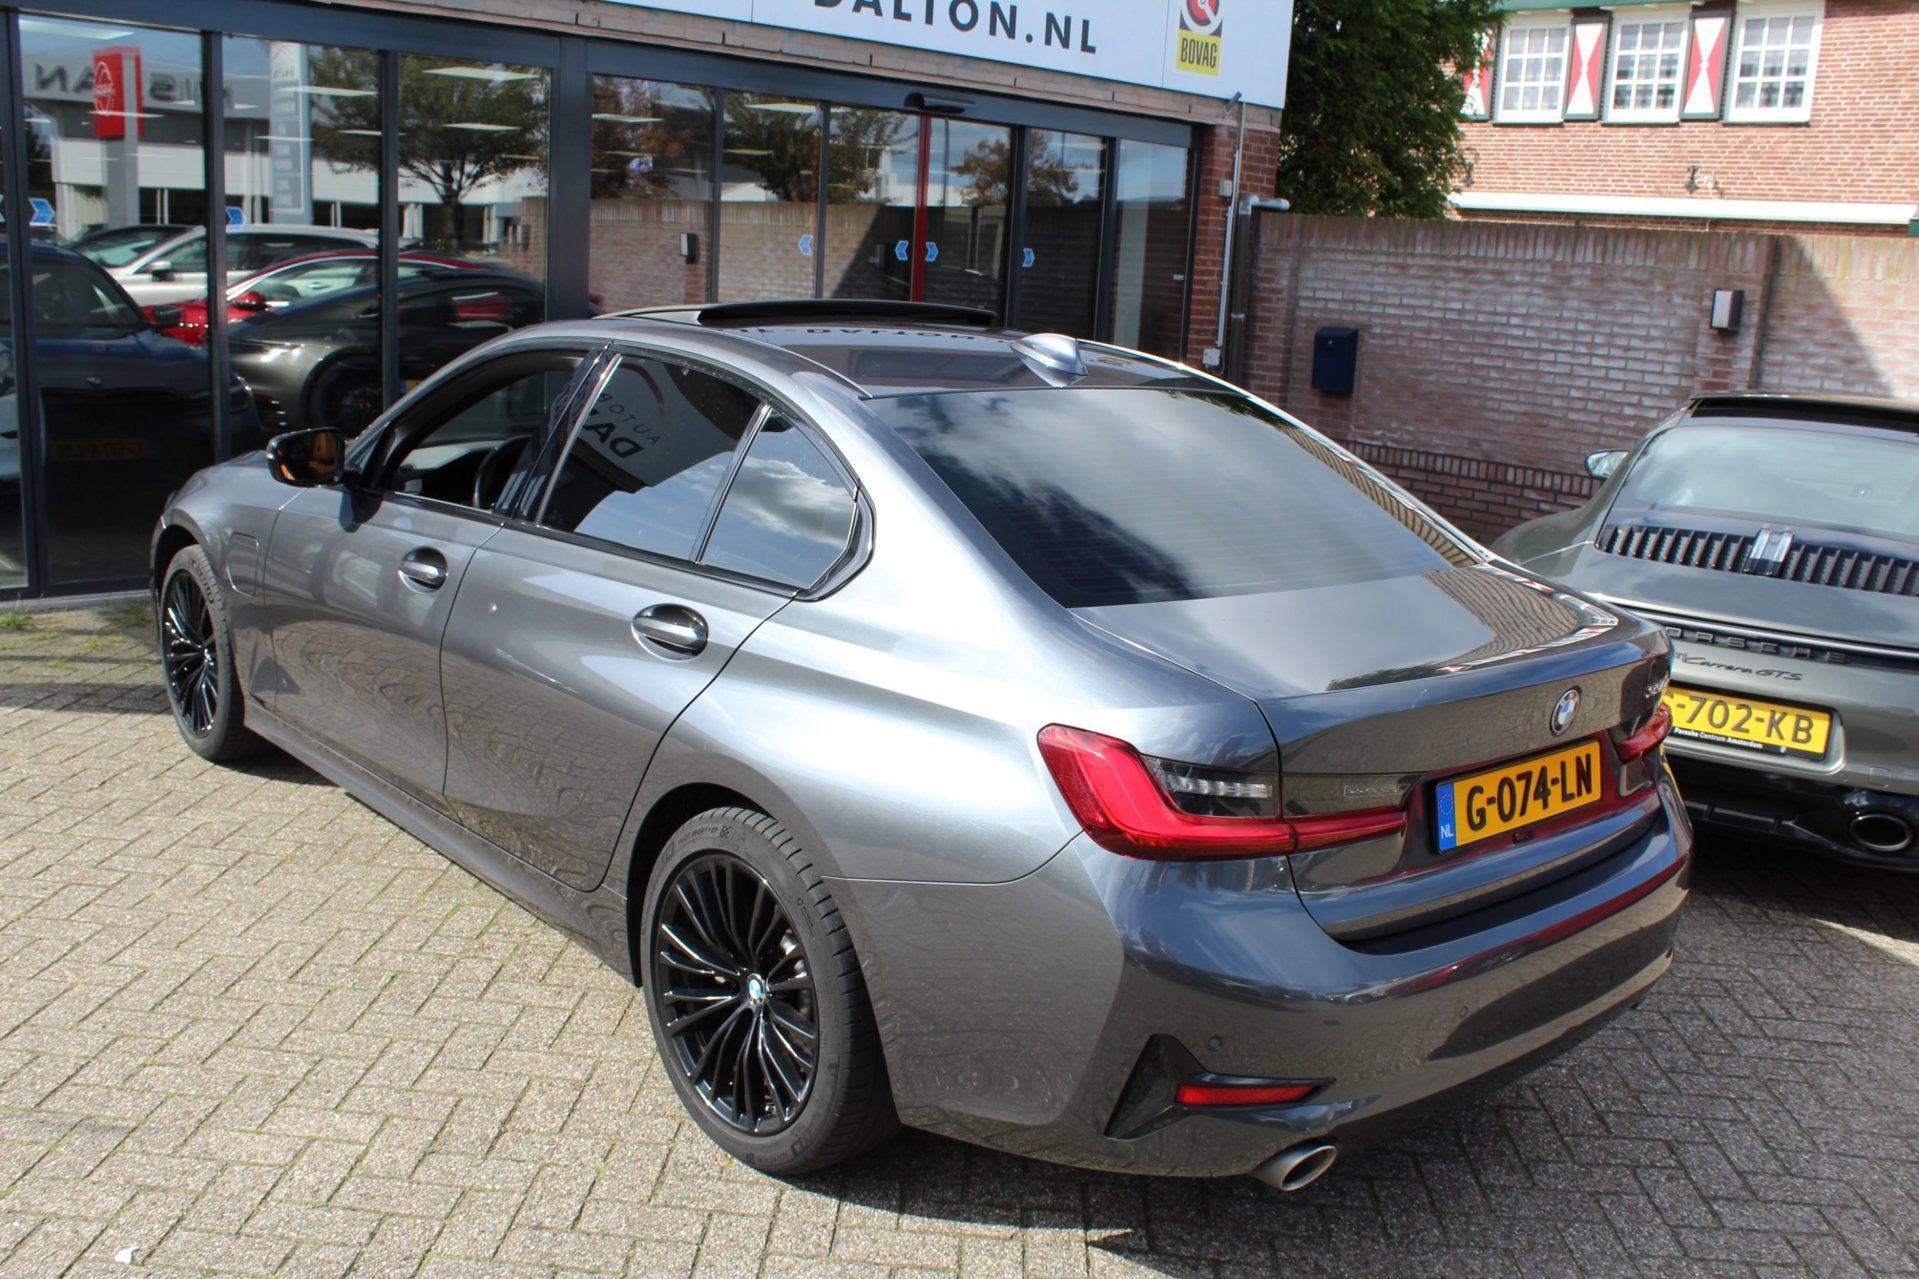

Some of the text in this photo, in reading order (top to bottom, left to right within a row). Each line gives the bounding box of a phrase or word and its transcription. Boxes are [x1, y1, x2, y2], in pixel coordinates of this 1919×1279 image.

[814, 0, 1097, 54] LON.NL
[1180, 37, 1217, 69] BOVAG
[1666, 626, 1848, 664] ORSCHE
[1684, 656, 1752, 675] Carrera
[1755, 669, 1803, 682] GTS
[1664, 690, 1814, 744] -702-KB
[1674, 727, 1763, 749] Porsche Centrum Amsterdam
[1466, 753, 1592, 832] G-074-LN
[1440, 823, 1454, 839] NL
